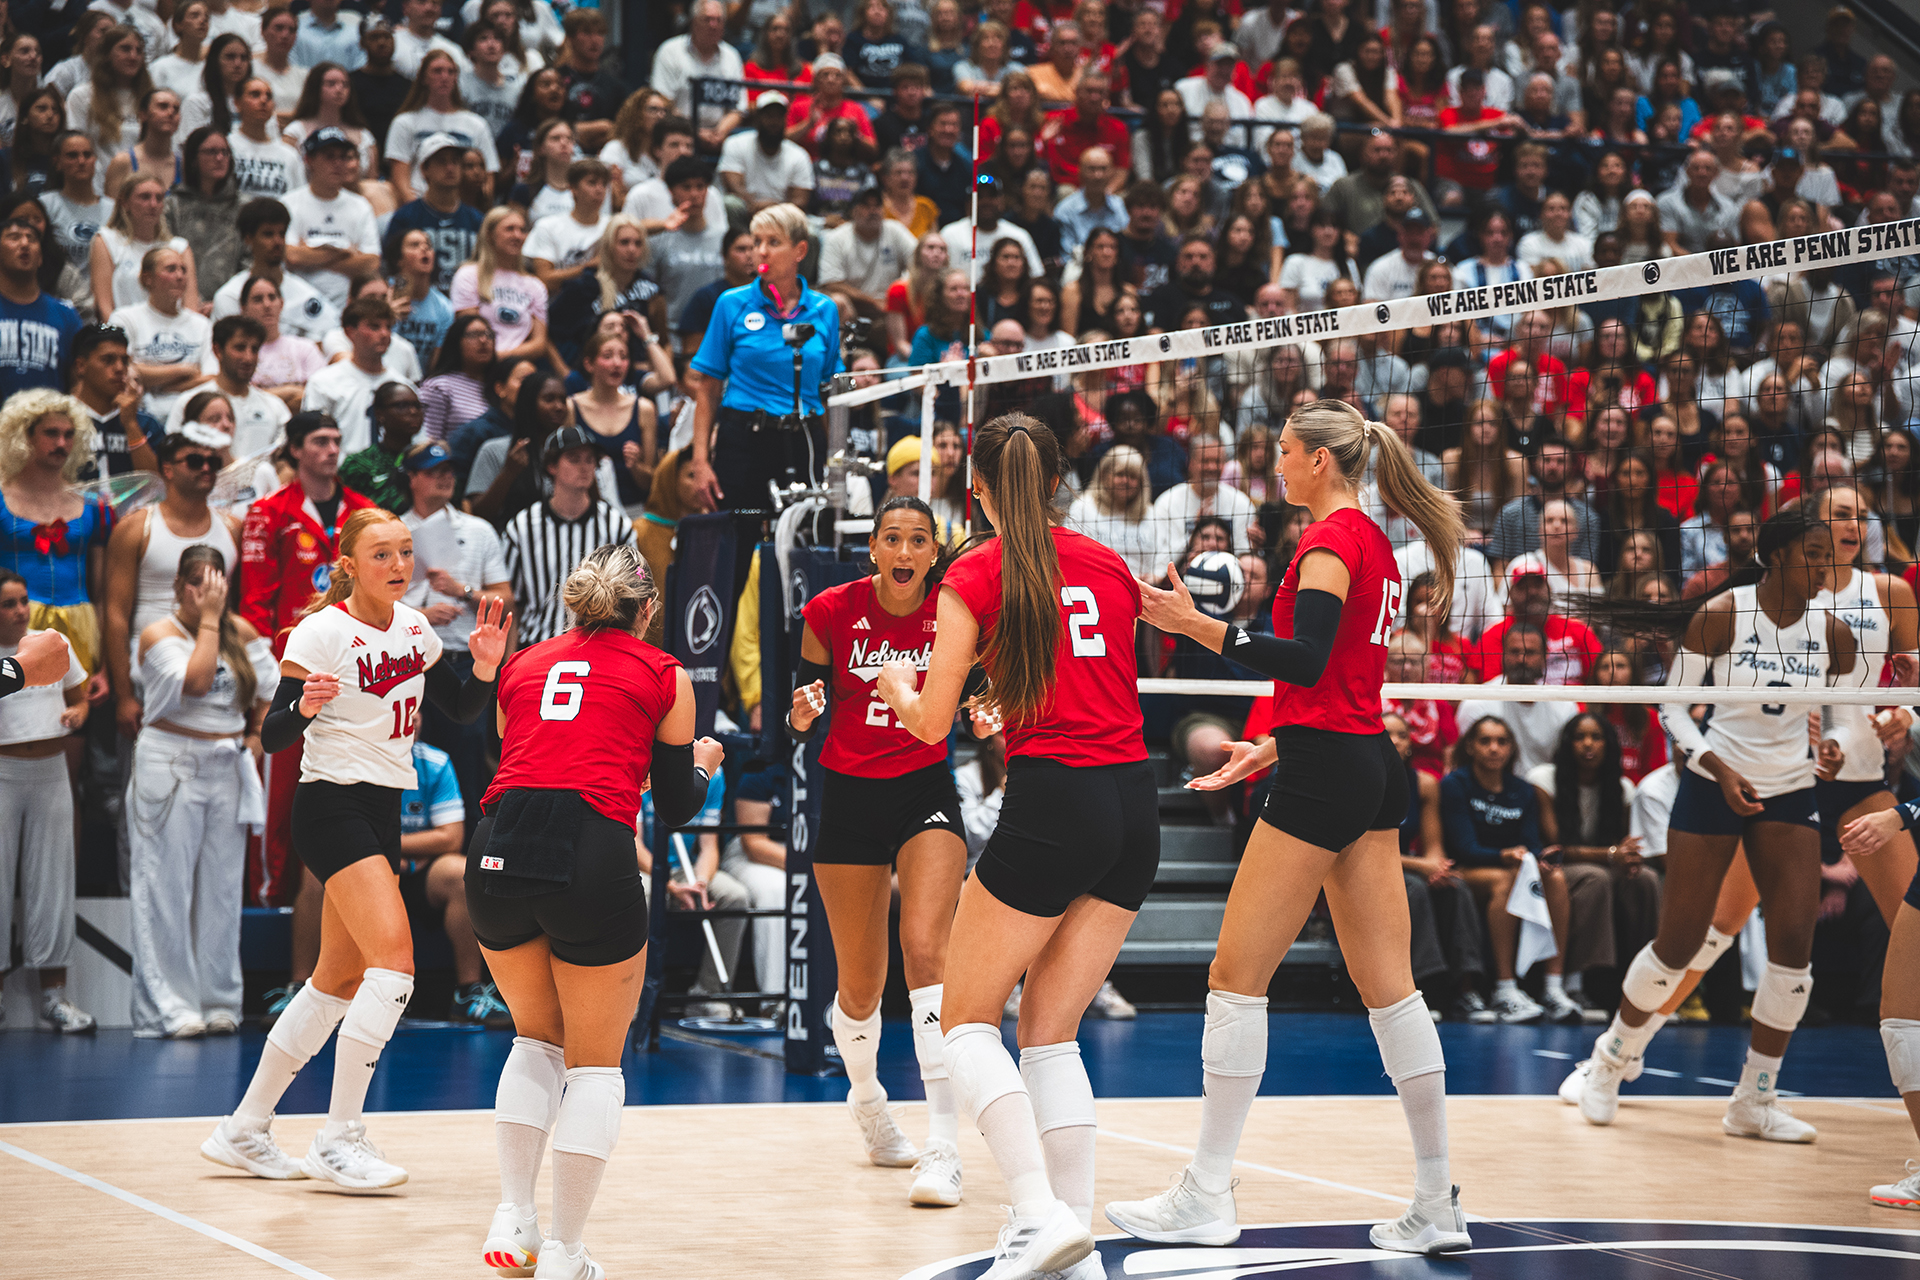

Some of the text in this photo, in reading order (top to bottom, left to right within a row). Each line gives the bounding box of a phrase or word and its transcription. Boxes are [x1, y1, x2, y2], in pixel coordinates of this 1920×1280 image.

[1709, 249, 1740, 275] WE
[1746, 241, 1787, 271] ARE
[1793, 231, 1851, 263] PENN
[1427, 271, 1598, 317] WE ARE PENN STATE
[20, 319, 60, 369] STATE
[1202, 311, 1339, 348] WE ARE PENN STATE
[1016, 341, 1131, 372] WE ARE PENN STATE
[1060, 586, 1107, 657] 2
[1369, 576, 1400, 648] 15
[356, 645, 426, 690] Nebrask
[847, 637, 932, 669] Nebrask
[1734, 650, 1822, 678] Penn State
[538, 660, 592, 721] 6
[865, 689, 920, 728] 2
[787, 672, 809, 1041] PENN STA
